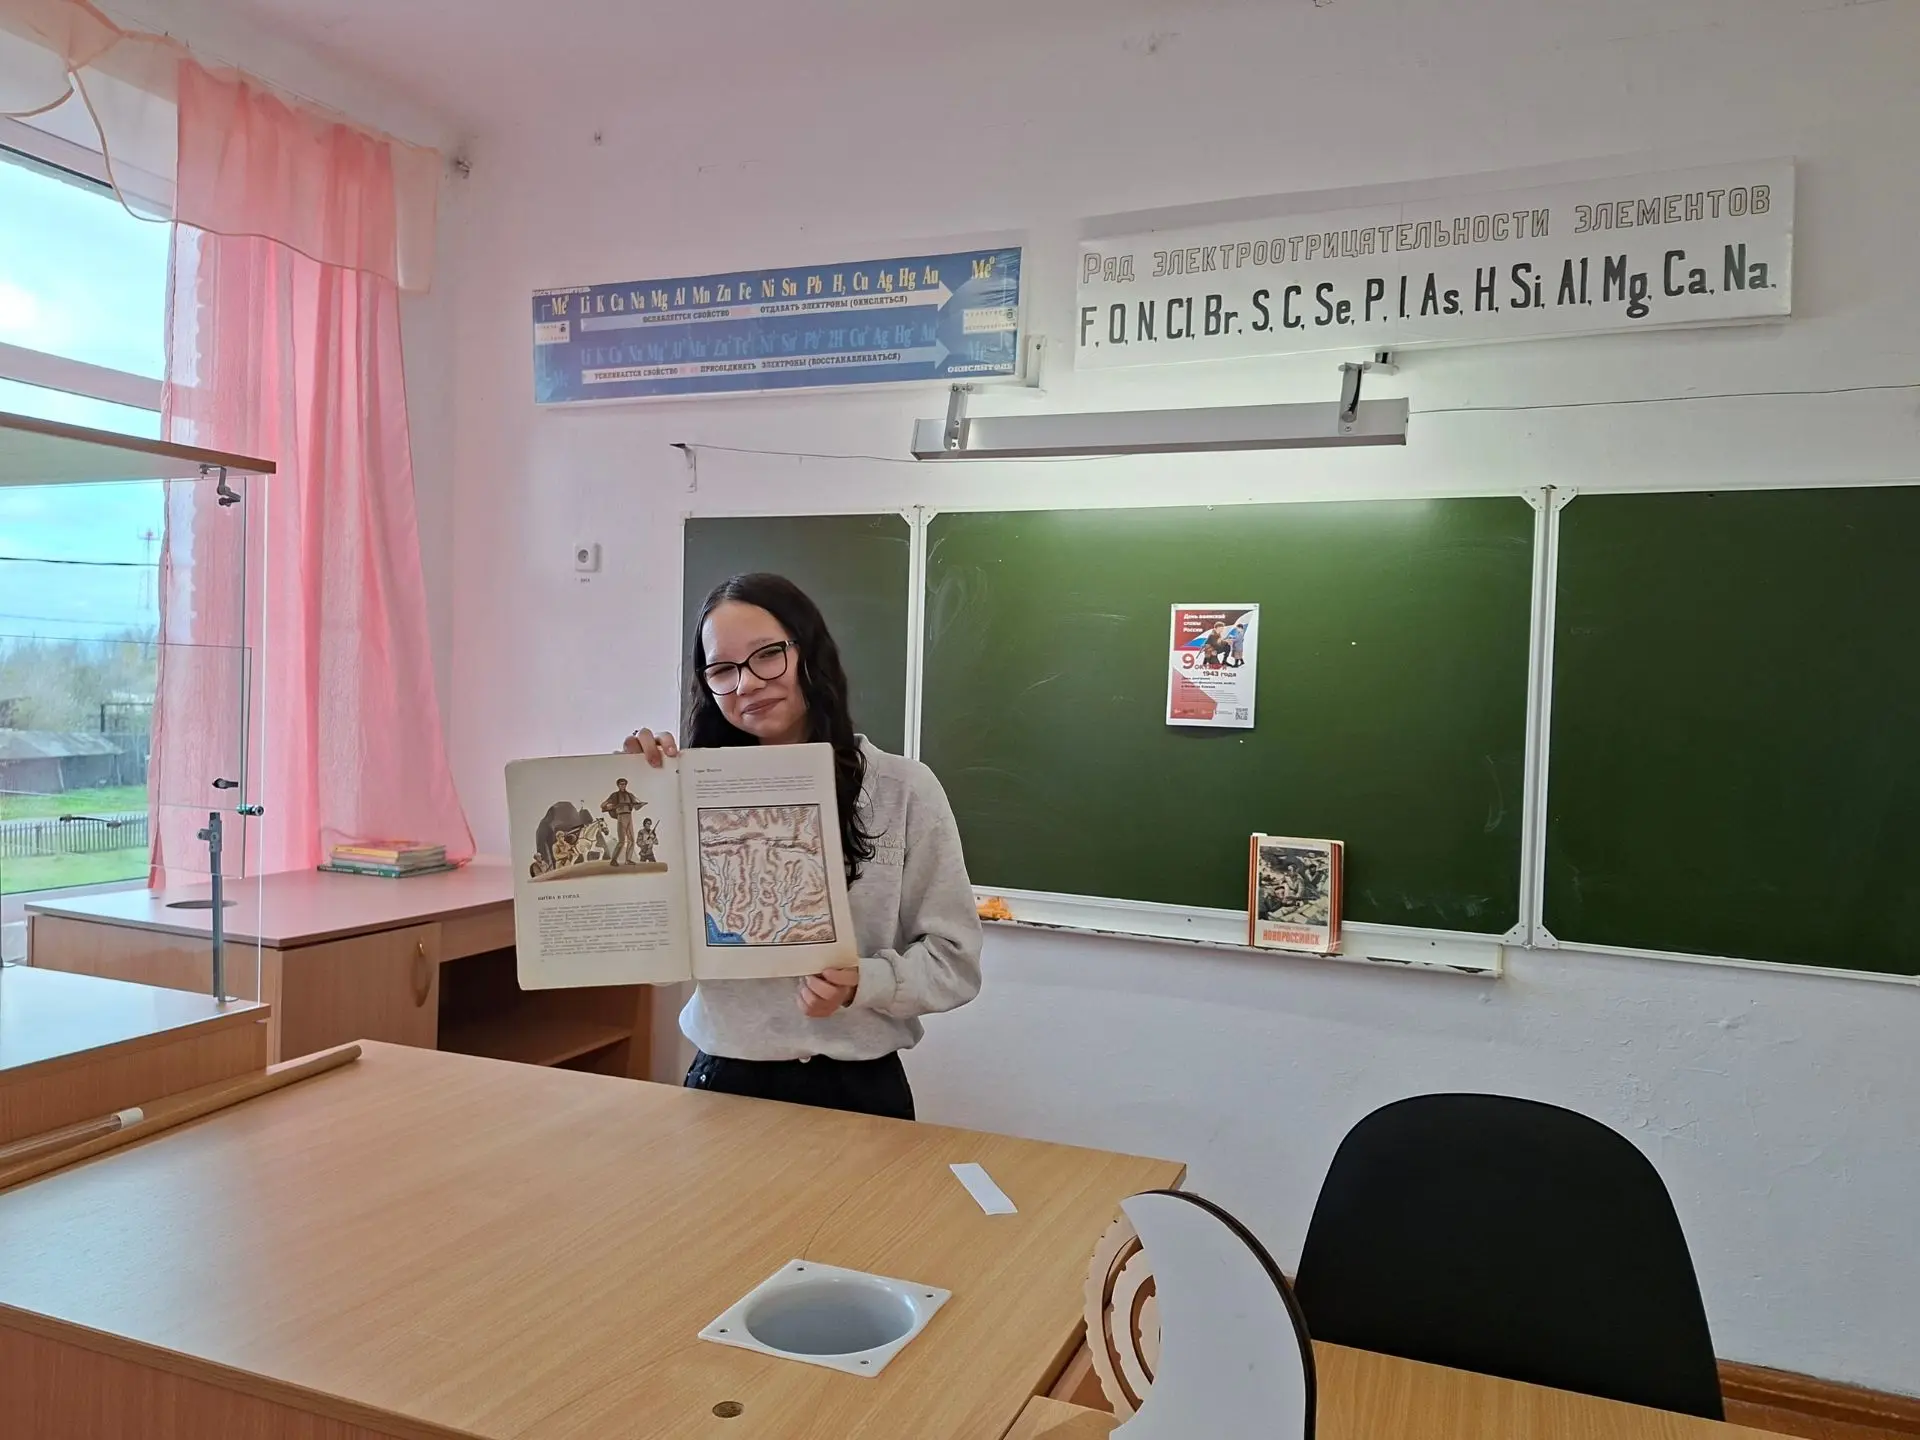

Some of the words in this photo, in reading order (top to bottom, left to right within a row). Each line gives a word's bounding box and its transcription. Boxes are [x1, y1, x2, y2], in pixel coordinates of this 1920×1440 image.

[1153, 208, 1549, 277] ЭЛЕКТРООТРИЦАТЕЛЬНОСТИ
[1574, 185, 1770, 234] ЭЛЕМЕНТОВ
[760, 303, 800, 314] ОТДАВАТЬ
[801, 299, 848, 311] ЭЛЕКТРОНЫ
[850, 295, 907, 308] (ОКИСЛЯТЬСЯ)
[693, 309, 729, 320] СВОЙСТВО
[761, 359, 806, 369] ЭЛЕКТРОНЫ
[643, 366, 678, 377] СВОЙСТВО
[1182, 653, 1195, 669] 9
